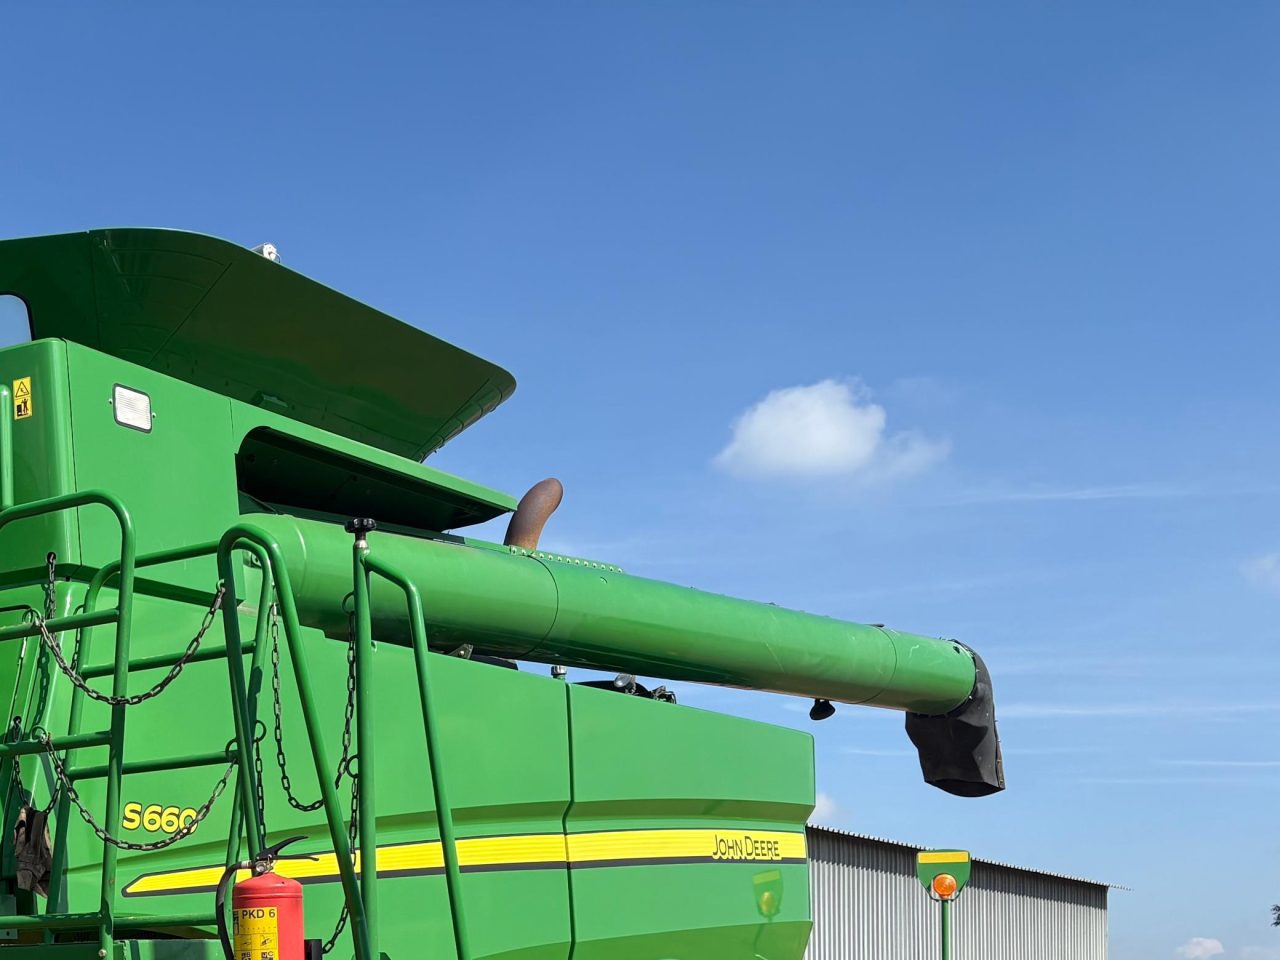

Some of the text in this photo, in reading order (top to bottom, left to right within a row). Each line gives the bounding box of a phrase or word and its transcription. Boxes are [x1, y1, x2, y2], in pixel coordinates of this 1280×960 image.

[122, 801, 198, 835] S660
[712, 834, 780, 857] JOHN DEERE
[241, 908, 276, 919] PKD 6
